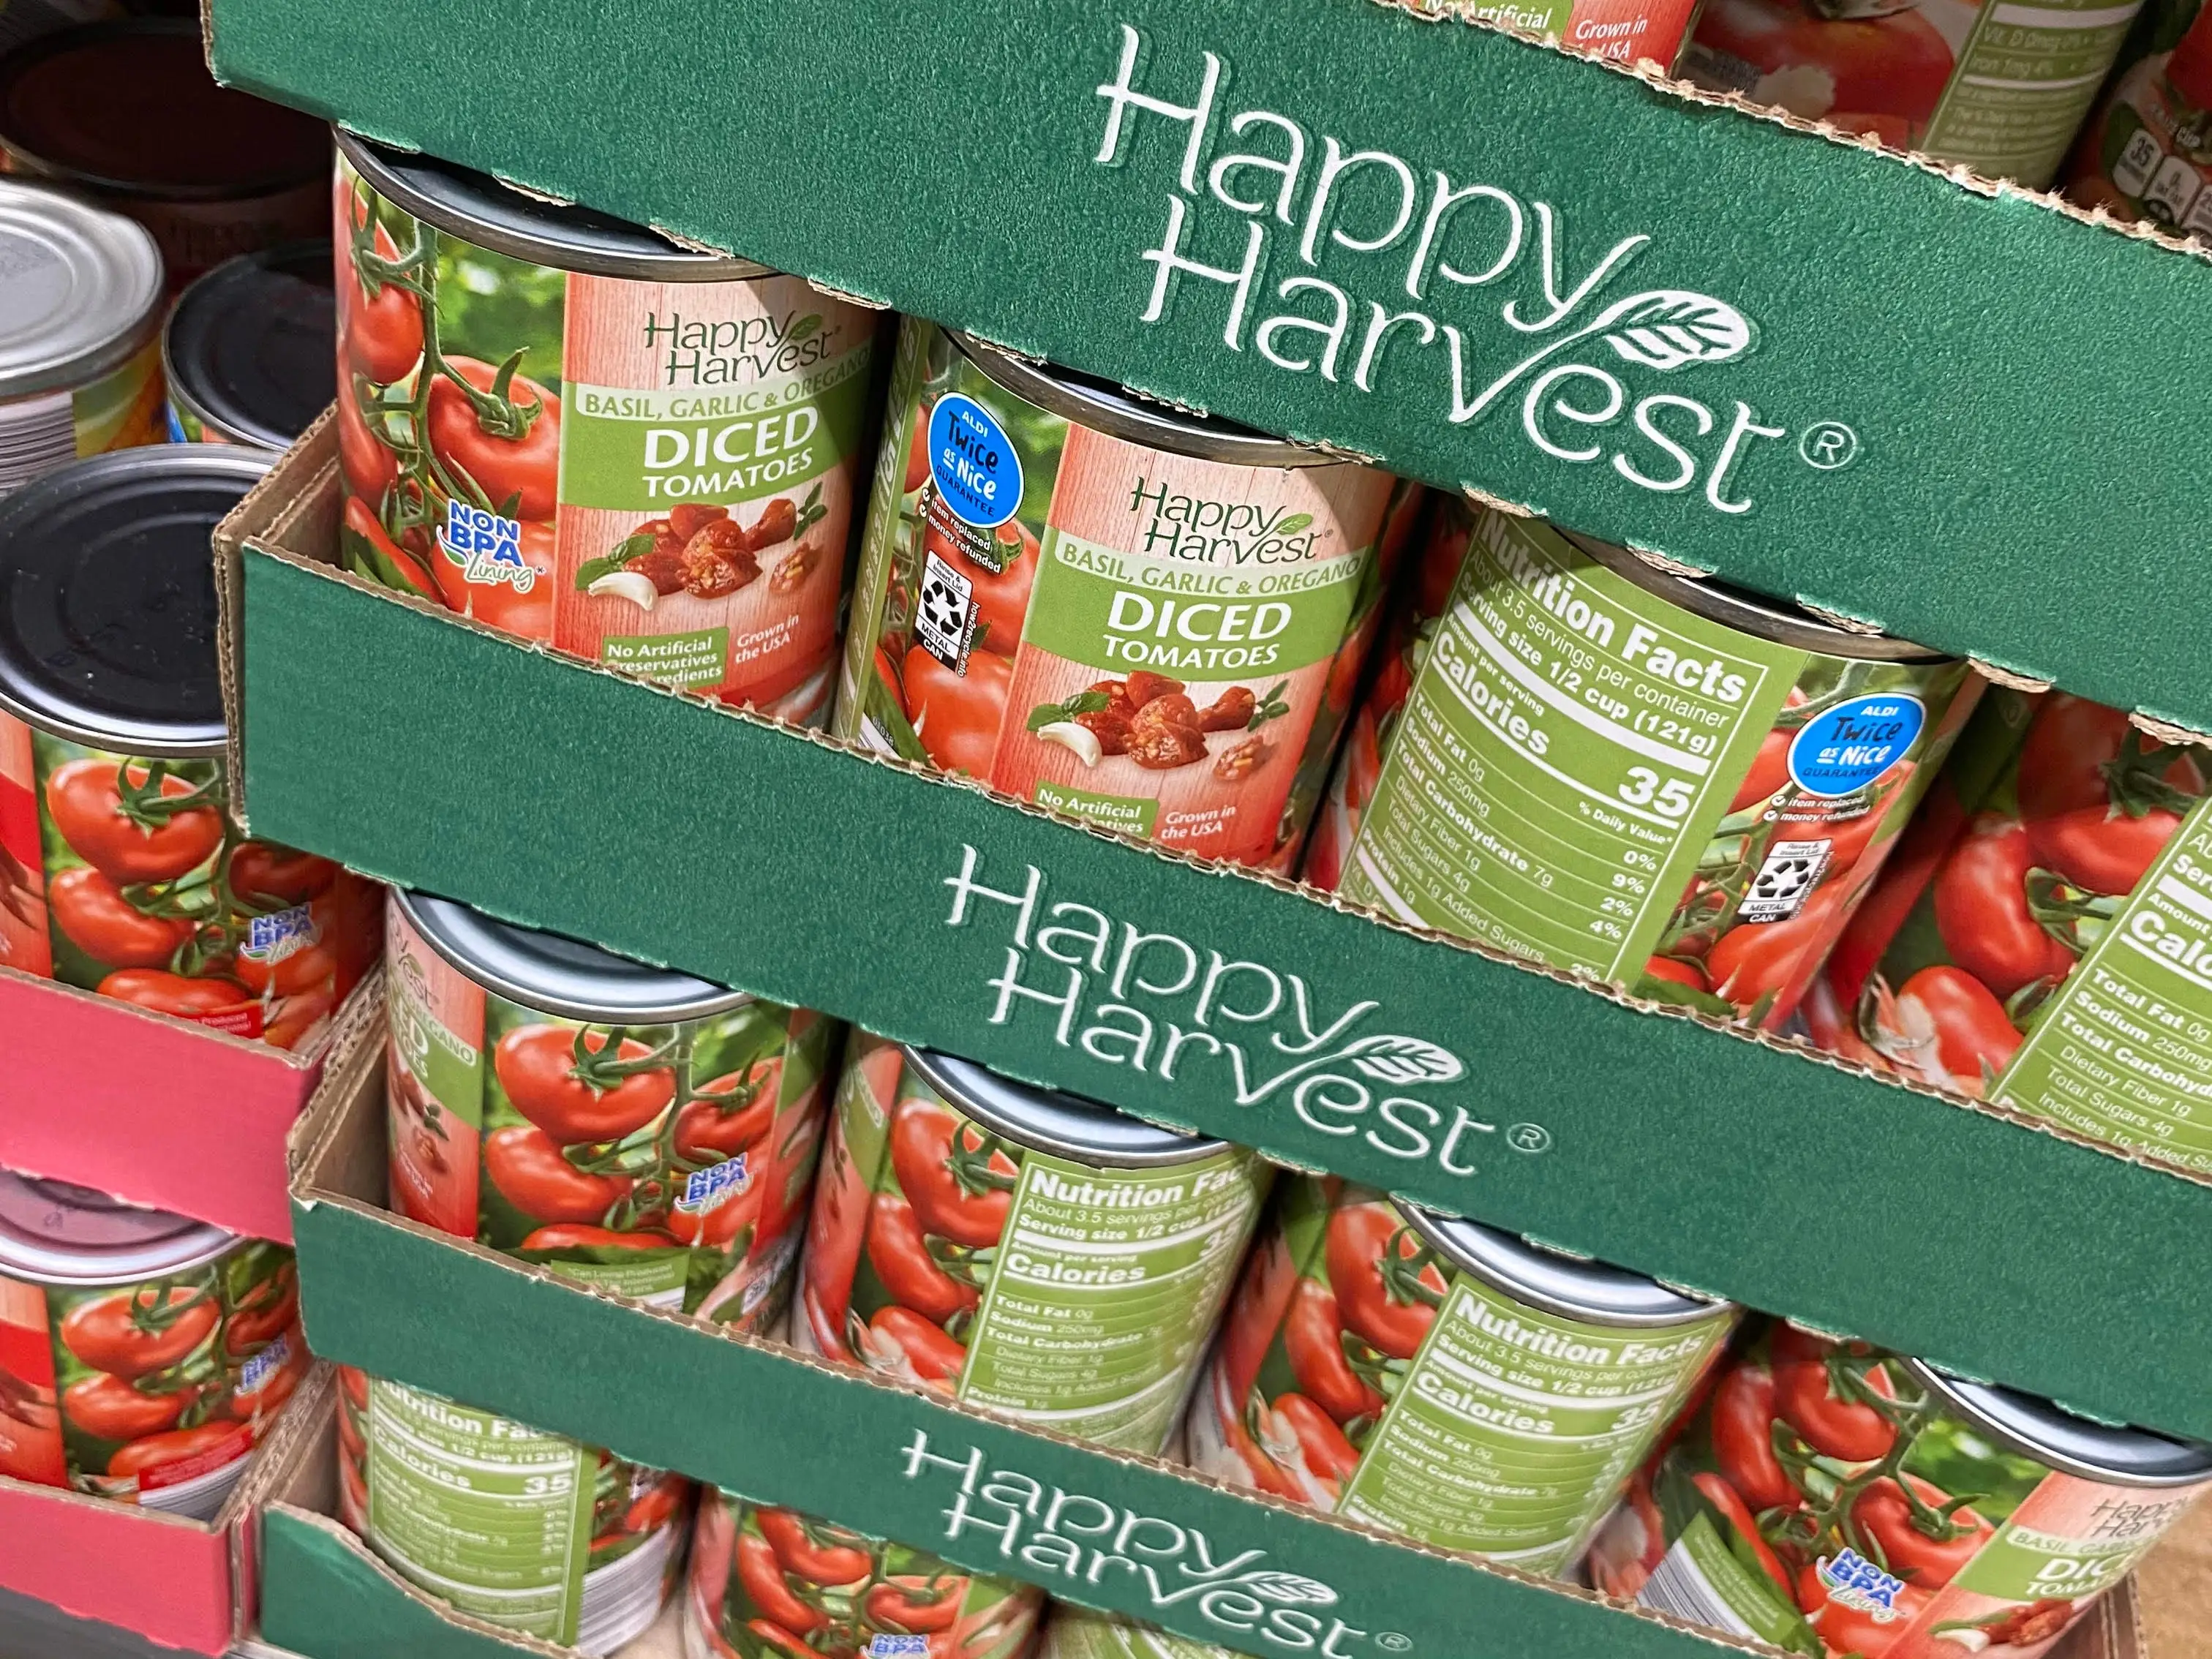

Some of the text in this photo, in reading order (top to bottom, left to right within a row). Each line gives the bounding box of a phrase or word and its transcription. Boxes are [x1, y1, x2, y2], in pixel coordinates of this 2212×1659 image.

[1576, 19, 1629, 39] Grown
[1633, 14, 1648, 33] in
[1094, 23, 1652, 334] Happy
[644, 310, 797, 356] Happy
[1138, 192, 1786, 514] Harvest
[666, 329, 835, 386] Harvest
[585, 347, 872, 421] BASIL, GARLIC & OREGANO
[644, 406, 819, 470] DICED
[948, 409, 999, 474] Twice
[962, 410, 988, 437] ALDI
[642, 447, 813, 498] TOMATOES
[936, 464, 996, 517] GUARANTEE
[944, 448, 997, 501] as Nice
[451, 501, 518, 541] NON
[931, 497, 992, 551] item replaced
[1129, 476, 1287, 536] Happy
[451, 521, 522, 568] BPA
[928, 514, 1001, 574] money refunded
[1145, 518, 1325, 565] Harvest
[933, 564, 963, 592] Insert Lid
[936, 559, 955, 580] Rinse
[1063, 541, 1361, 595] BASIL, GARLIC & OREGANO
[1106, 590, 1293, 643] DICED
[1480, 511, 1748, 702] Nutrition Facts
[607, 636, 712, 658] No Artificial
[735, 633, 791, 664] the USA
[737, 614, 800, 648] Grown in
[921, 622, 950, 653] METAL
[923, 639, 944, 661] CAN
[957, 601, 981, 677] how2recycle.info
[1102, 634, 1280, 669] TOMATOES
[610, 652, 718, 672] reservatives
[1447, 613, 1545, 718] Amount per serving
[1460, 571, 1718, 756] Serving size 1/2 cup (121g)
[1502, 588, 1730, 729] 3.5 servings per container
[1437, 631, 1696, 818] Calories 35
[1830, 716, 1903, 742] Twice
[1861, 705, 1900, 717] ALDI
[1802, 766, 1882, 778] GUARANTEE
[1817, 745, 1892, 766] as Nice
[1038, 788, 1142, 818] No Artificial
[1414, 692, 1657, 870] Total Fat 0g 0%
[1165, 805, 1237, 825] Grown in
[1396, 741, 1633, 917] Total Carbohydrate 7g 2%
[1405, 717, 1645, 894] Sodium 250mg 9%
[1592, 808, 1627, 832] Daily
[1780, 812, 1819, 823] money
[1160, 825, 1188, 840] the
[1190, 821, 1224, 836] USA
[1410, 827, 1451, 876] Sugars
[1363, 827, 1400, 885] Protein
[1395, 775, 1622, 939] Dietary Fiber 4%
[1382, 824, 1545, 962] Includes Added Sugars
[1748, 902, 1786, 912] METAL
[2148, 892, 2211, 935] Amount
[254, 919, 311, 946] BPA
[1749, 913, 1776, 923] CAN
[943, 842, 1380, 1053] Happy
[2130, 910, 2212, 977] Calo
[2074, 990, 2151, 1043] Sodium
[2092, 968, 2211, 1042] Total Fat 0g
[988, 947, 1496, 1176] Harvest
[2061, 1012, 2212, 1097] Total Carbohyd
[2047, 1065, 2175, 1137] Total Sugars 4g
[2060, 1045, 2192, 1118] Dietary Fiber 1g
[2039, 1092, 2107, 1136] Includes
[689, 1167, 745, 1200] BPA
[690, 1155, 745, 1185] NON
[1028, 1169, 1184, 1208] Nutrition
[1191, 1165, 1243, 1197] Fac
[1018, 1214, 1165, 1241] Serving size 1/2
[1023, 1198, 1172, 1225] About servings
[1005, 1252, 1146, 1282] Calories
[990, 1311, 1053, 1333] Sodium
[996, 1295, 1072, 1317] Total Fat
[1454, 1293, 1706, 1366] Nutrition Facts
[987, 1326, 1143, 1349] Total Carbohydrate
[1445, 1320, 1593, 1382] About 3.5 servings
[1437, 1333, 1622, 1397] Serving size 1/2 cup
[968, 1385, 1027, 1406] Protein
[1416, 1370, 1661, 1434] Calories 35
[1389, 1424, 1451, 1462] Sodium
[1399, 1408, 1472, 1453] Total Fat
[374, 1425, 573, 1494] Calories 35
[1382, 1438, 1539, 1497] Total Carbohydrate
[900, 1428, 1268, 1579] Happy
[941, 1494, 1368, 1659] Harvest
[1830, 1560, 1891, 1608] BPA
[1841, 1550, 1903, 1592] NON
[2035, 1551, 2129, 1581] DIC
